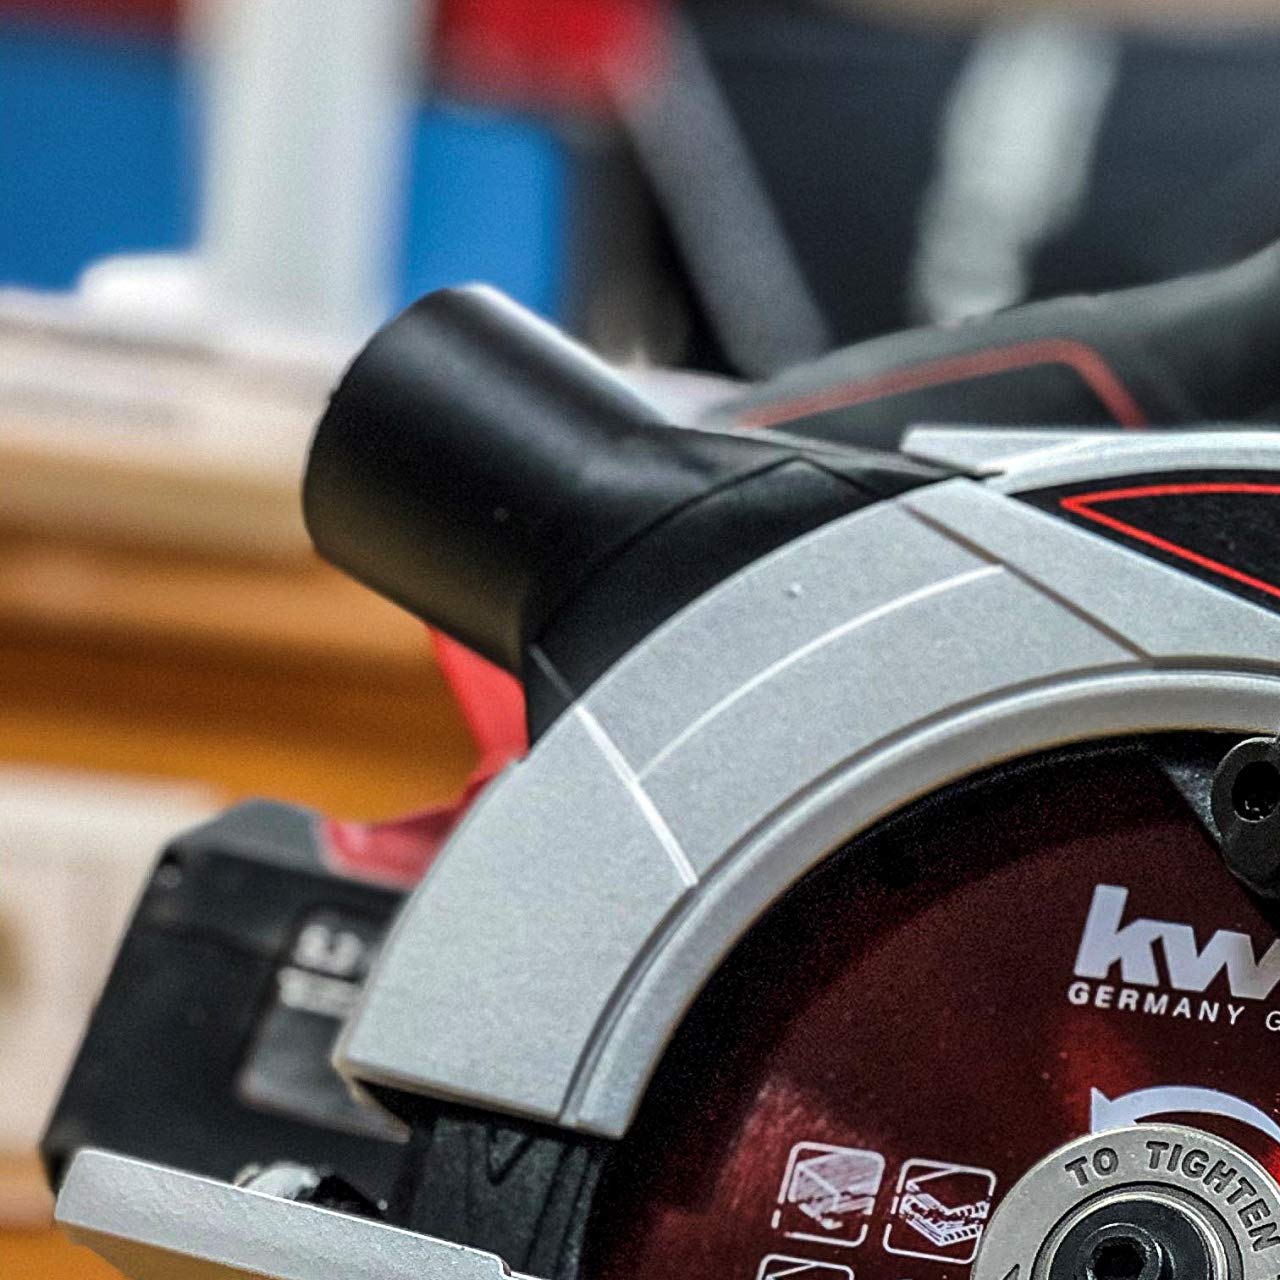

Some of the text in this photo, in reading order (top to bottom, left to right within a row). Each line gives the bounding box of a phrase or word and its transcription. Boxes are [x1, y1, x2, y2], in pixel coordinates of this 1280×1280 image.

[1068, 981, 1245, 1025] GERMANY
[1065, 1147, 1119, 1186] TO
[1146, 1140, 1280, 1252] TIGHTEN
